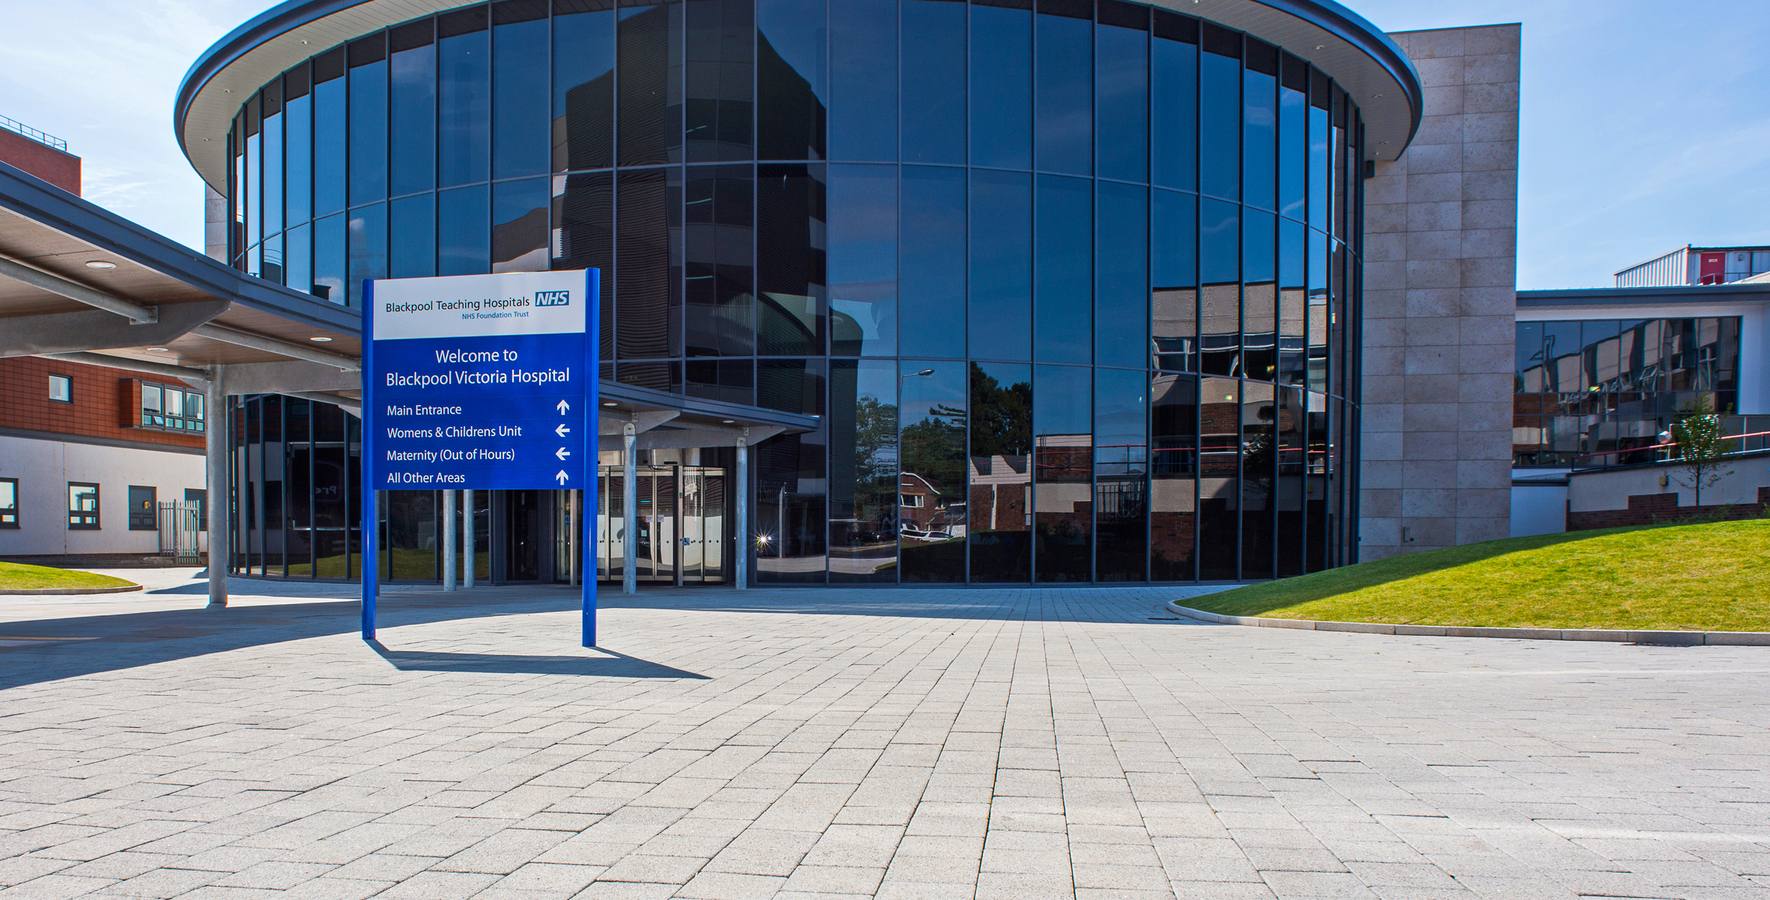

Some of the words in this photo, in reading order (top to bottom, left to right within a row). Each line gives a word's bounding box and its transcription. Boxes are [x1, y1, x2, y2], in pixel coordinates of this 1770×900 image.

[386, 302, 433, 313] Blackpool
[437, 300, 480, 310] Teaching
[484, 297, 530, 309] Hospitals
[535, 291, 569, 307] NHS
[436, 349, 500, 363] Welcome
[503, 350, 518, 361] to
[387, 371, 452, 388] Blackpool
[455, 371, 507, 384] Victoria
[512, 368, 570, 384] Hospital
[387, 405, 413, 416] Main
[415, 405, 462, 415] Entrance
[387, 428, 433, 438] Womens
[435, 427, 443, 438] &
[445, 426, 496, 438] Childrens
[499, 426, 522, 436] Unit
[387, 450, 437, 463] Maternity
[440, 450, 463, 462] (Out
[465, 449, 477, 460] of
[480, 449, 515, 461] Hours)
[387, 473, 401, 483] All
[403, 473, 434, 483] Other
[436, 472, 465, 483] Areas
